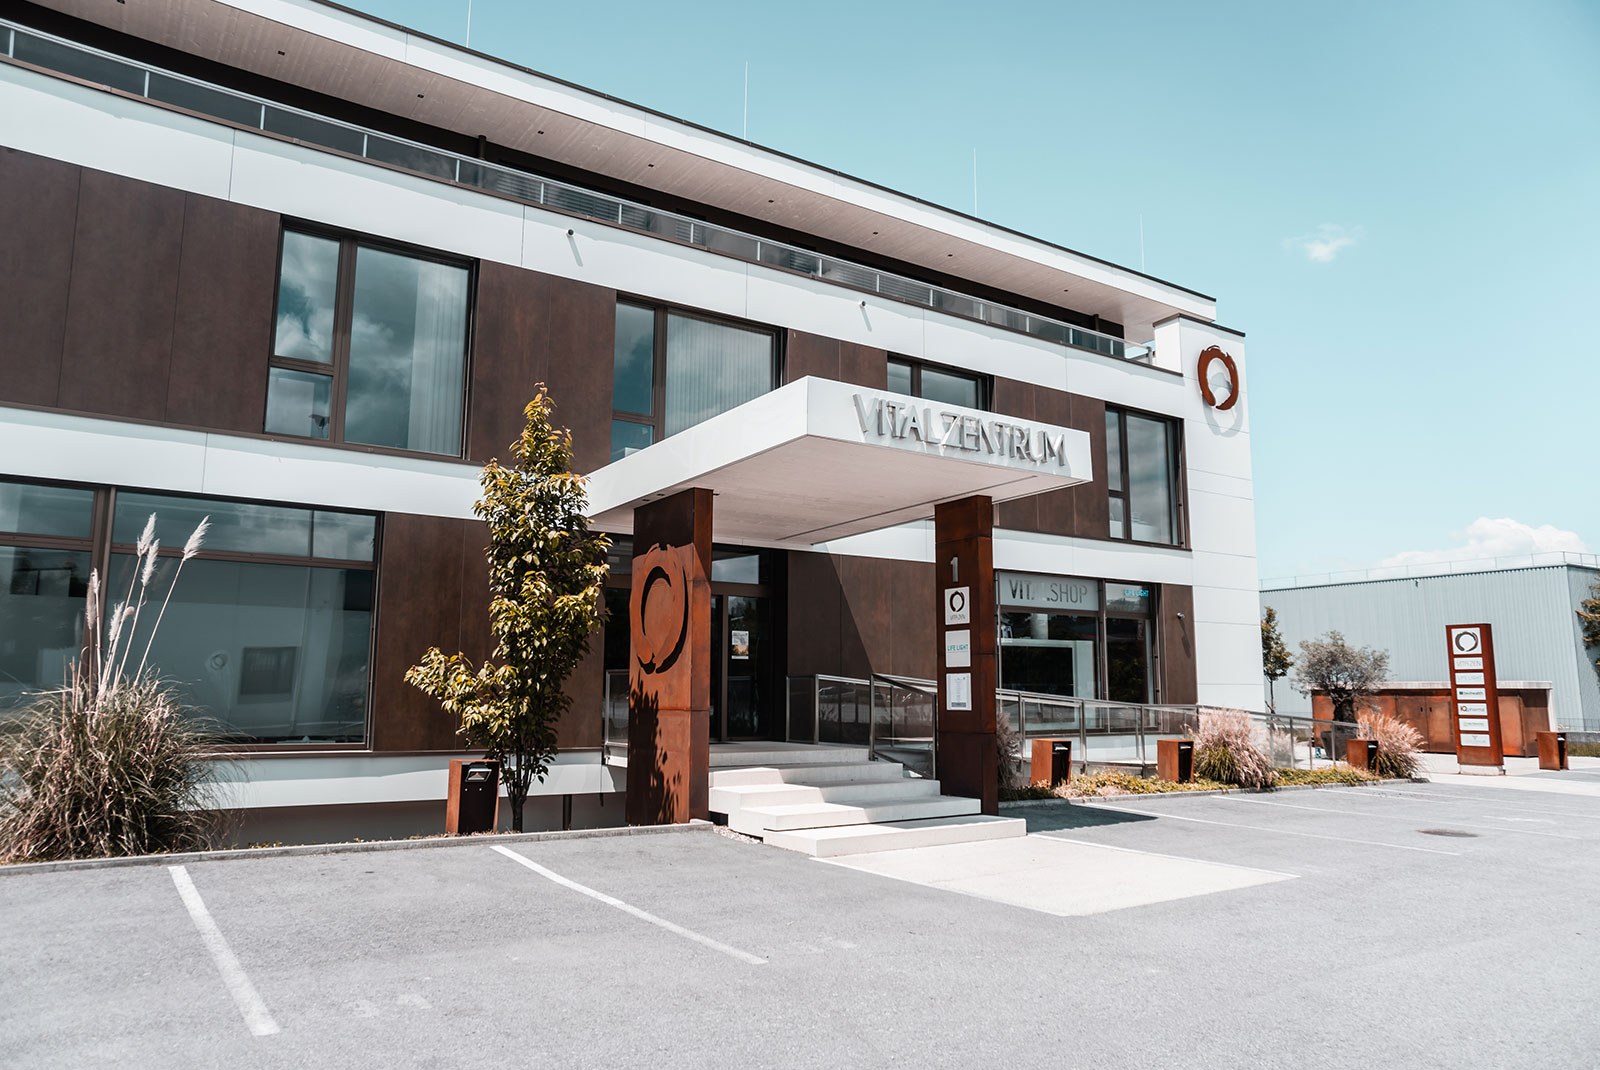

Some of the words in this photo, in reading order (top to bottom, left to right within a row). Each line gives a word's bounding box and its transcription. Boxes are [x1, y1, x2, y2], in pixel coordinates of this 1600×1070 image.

[852, 393, 1065, 467] VITALZENTRUM
[950, 556, 958, 582] 1
[947, 644, 956, 652] LIFE
[956, 643, 968, 651] LIGHT
